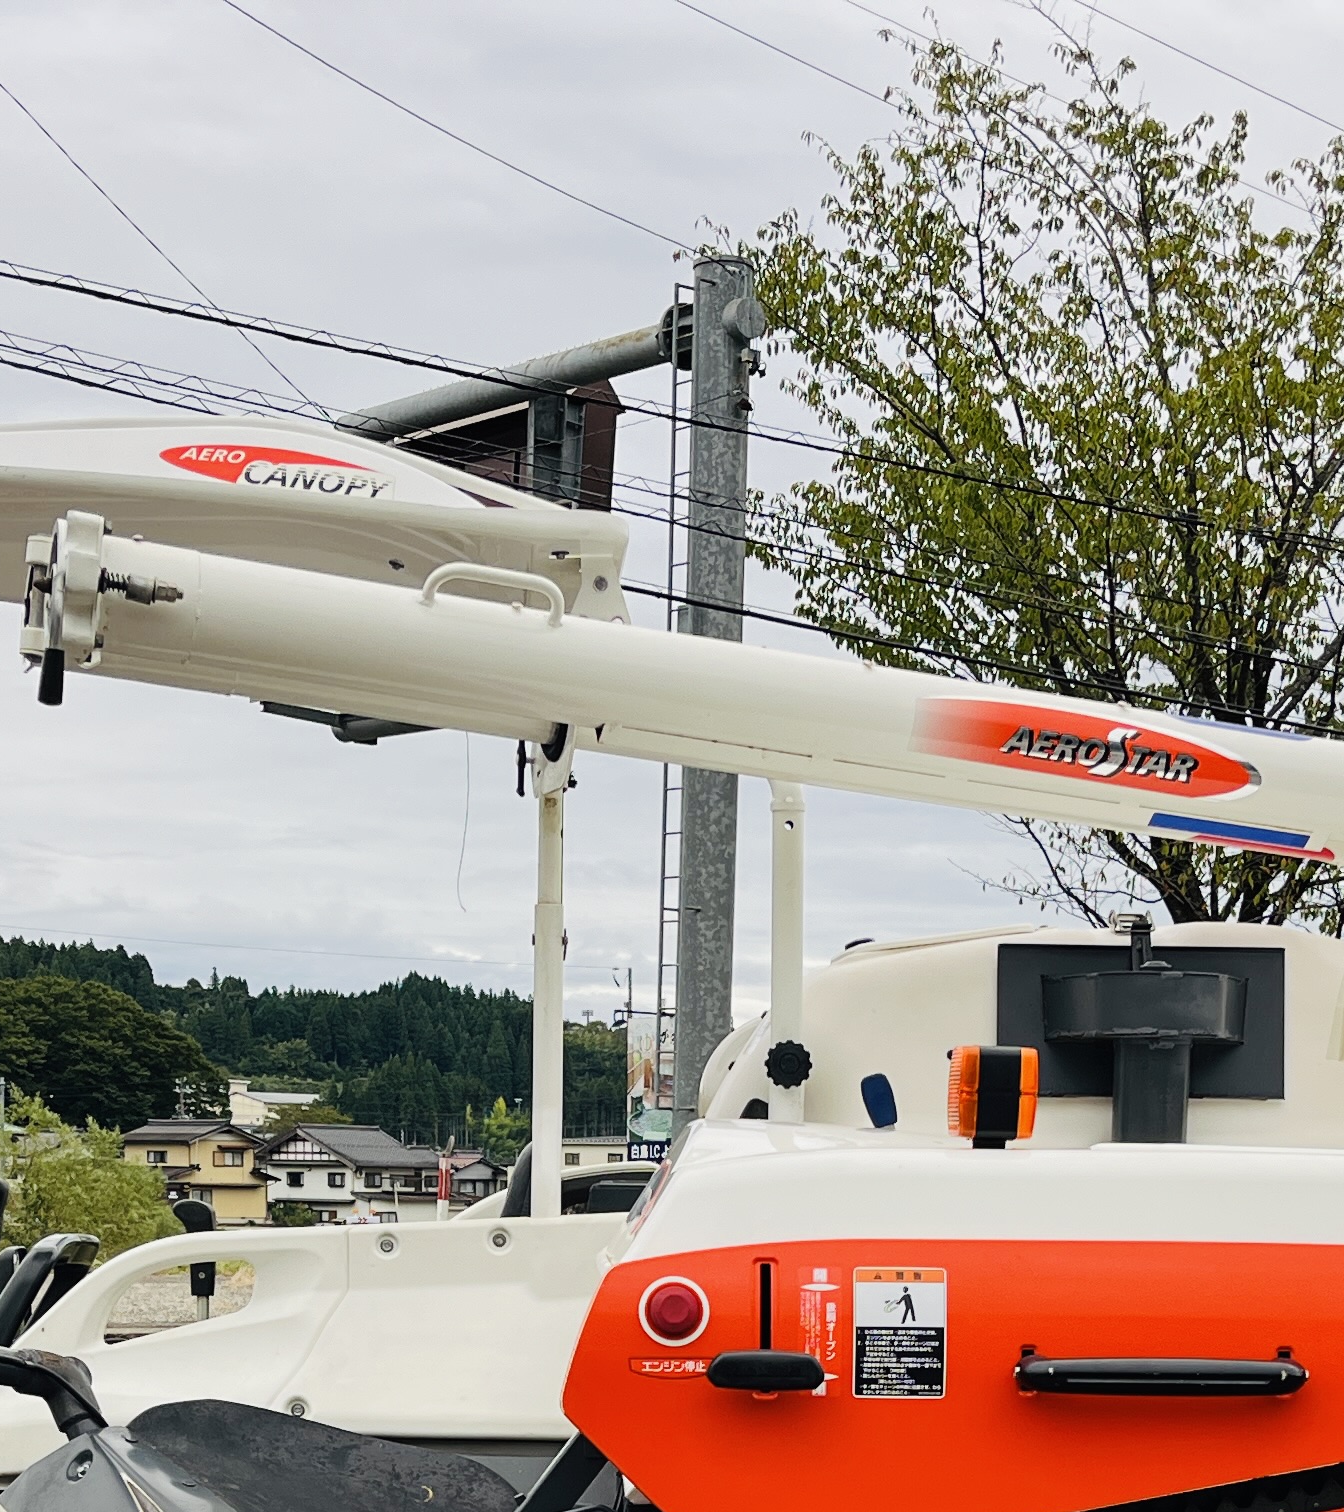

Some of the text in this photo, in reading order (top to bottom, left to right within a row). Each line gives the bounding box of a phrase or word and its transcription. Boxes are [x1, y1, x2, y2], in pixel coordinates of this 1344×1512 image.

[179, 447, 246, 464] AERO
[244, 461, 393, 499] CANOPY
[999, 726, 1200, 784] AEROSTAR
